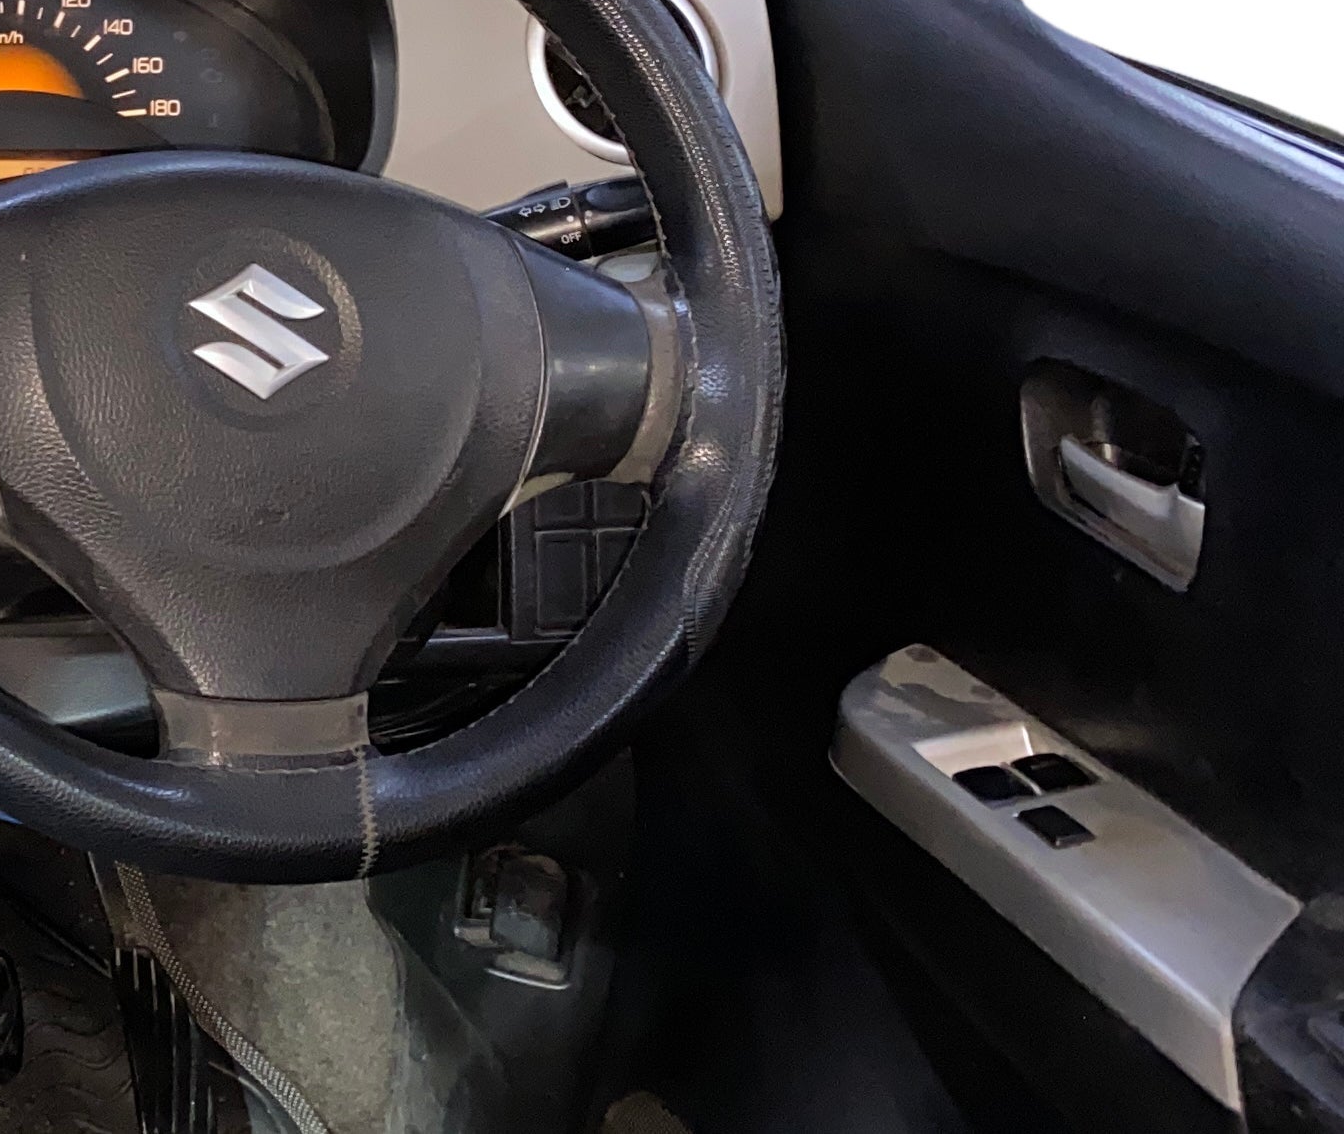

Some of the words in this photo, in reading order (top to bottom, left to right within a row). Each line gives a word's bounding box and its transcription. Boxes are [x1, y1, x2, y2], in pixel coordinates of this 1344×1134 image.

[103, 19, 133, 35] 140
[132, 57, 163, 74] 160
[150, 99, 180, 116] 180
[561, 231, 581, 244] OFF
